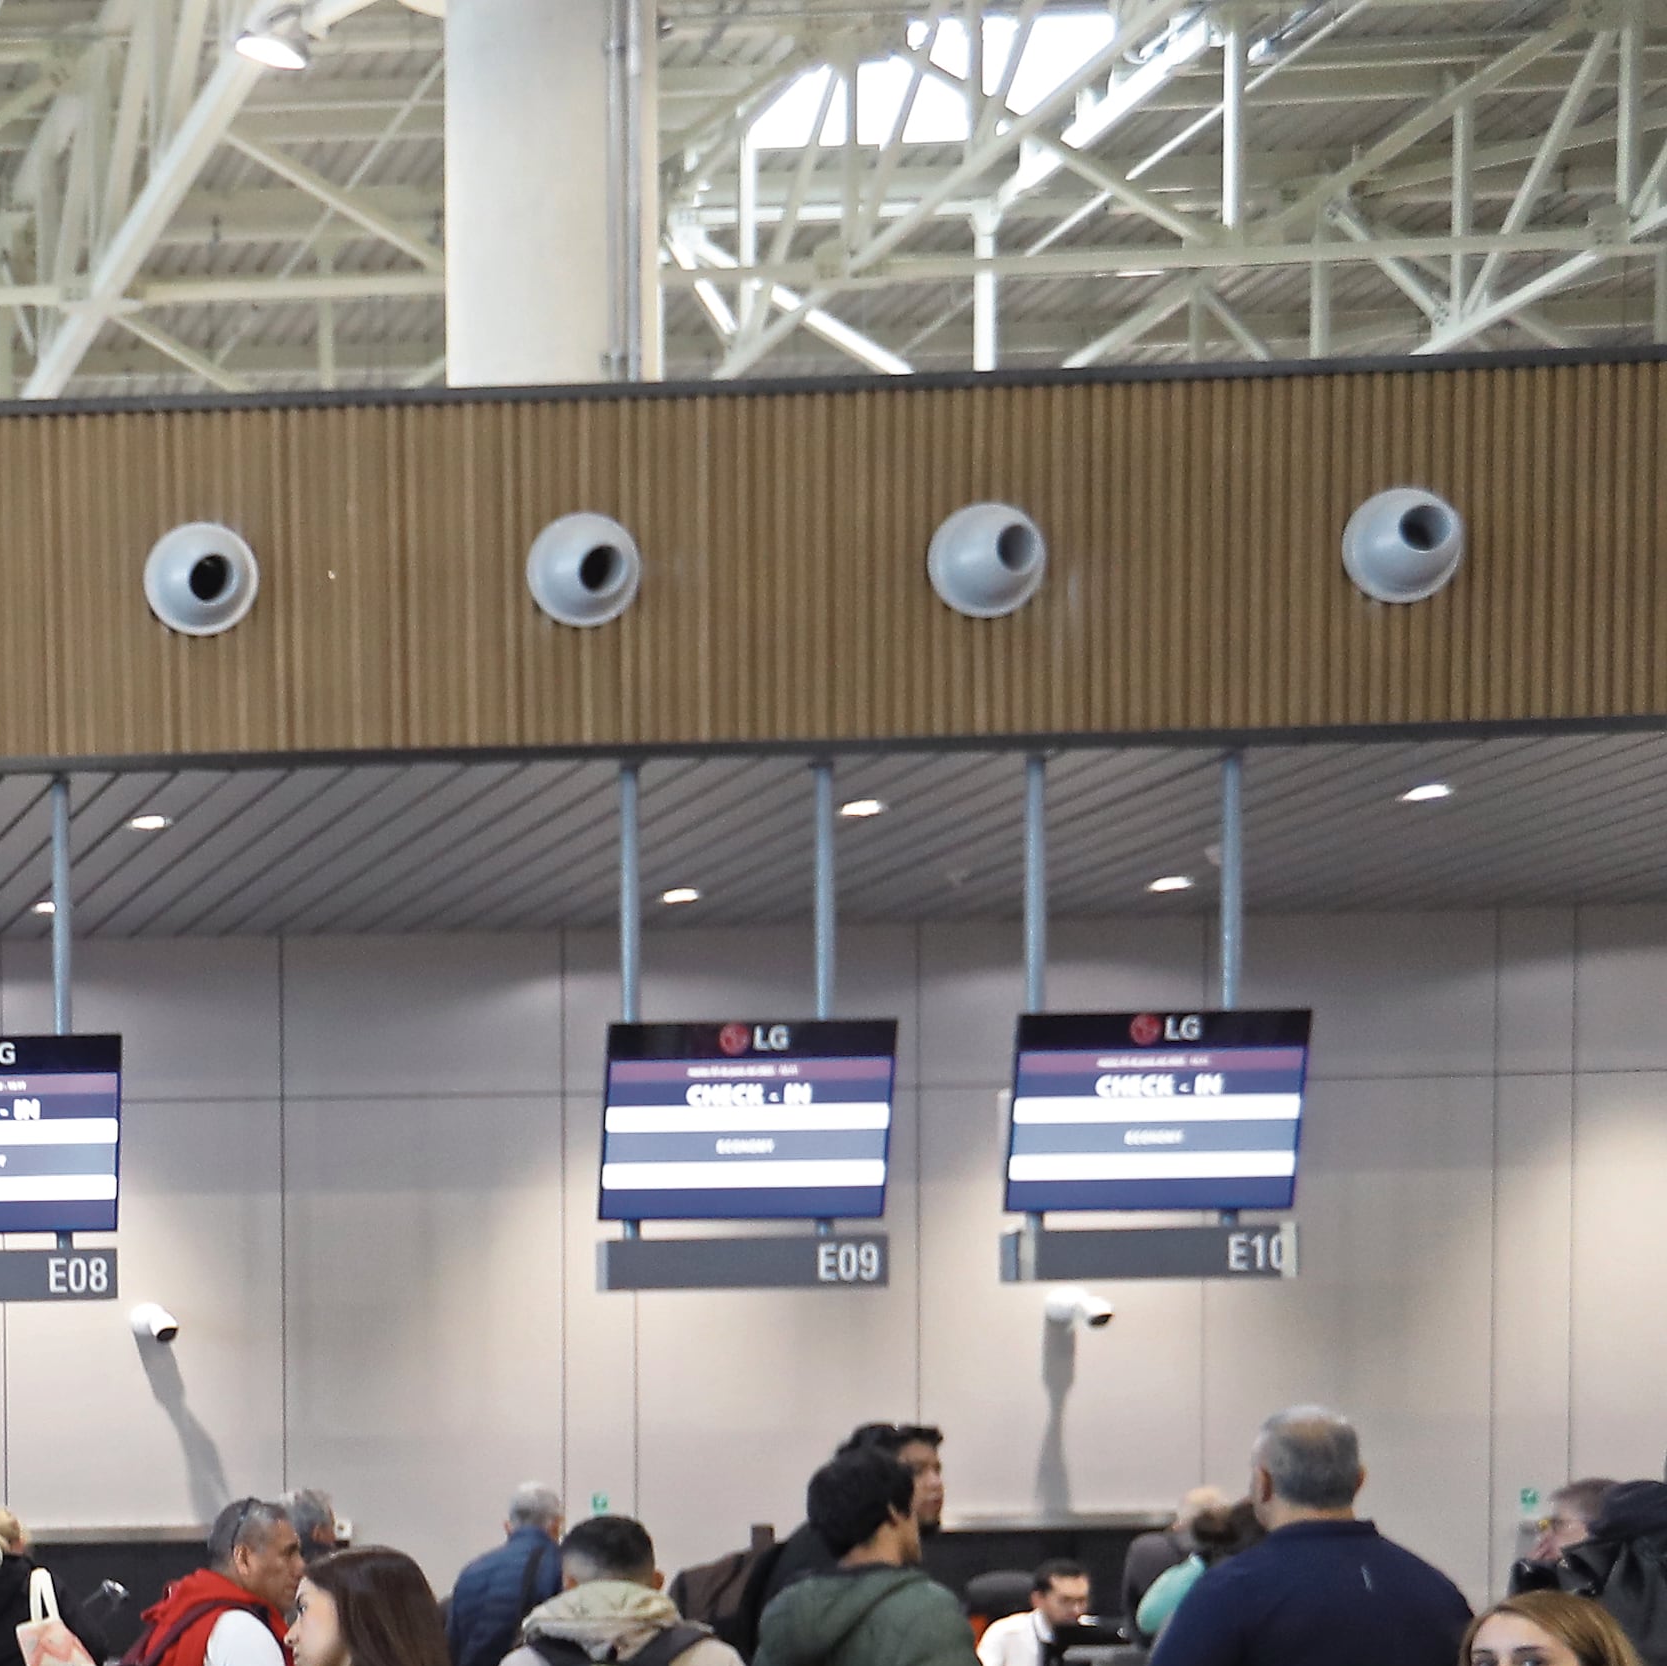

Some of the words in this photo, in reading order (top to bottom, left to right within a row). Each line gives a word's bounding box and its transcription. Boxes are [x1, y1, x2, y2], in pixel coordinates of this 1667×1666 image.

[753, 1025, 789, 1050] LG
[1164, 1016, 1201, 1041] LG
[48, 1257, 108, 1293] E08
[817, 1242, 880, 1281] E09
